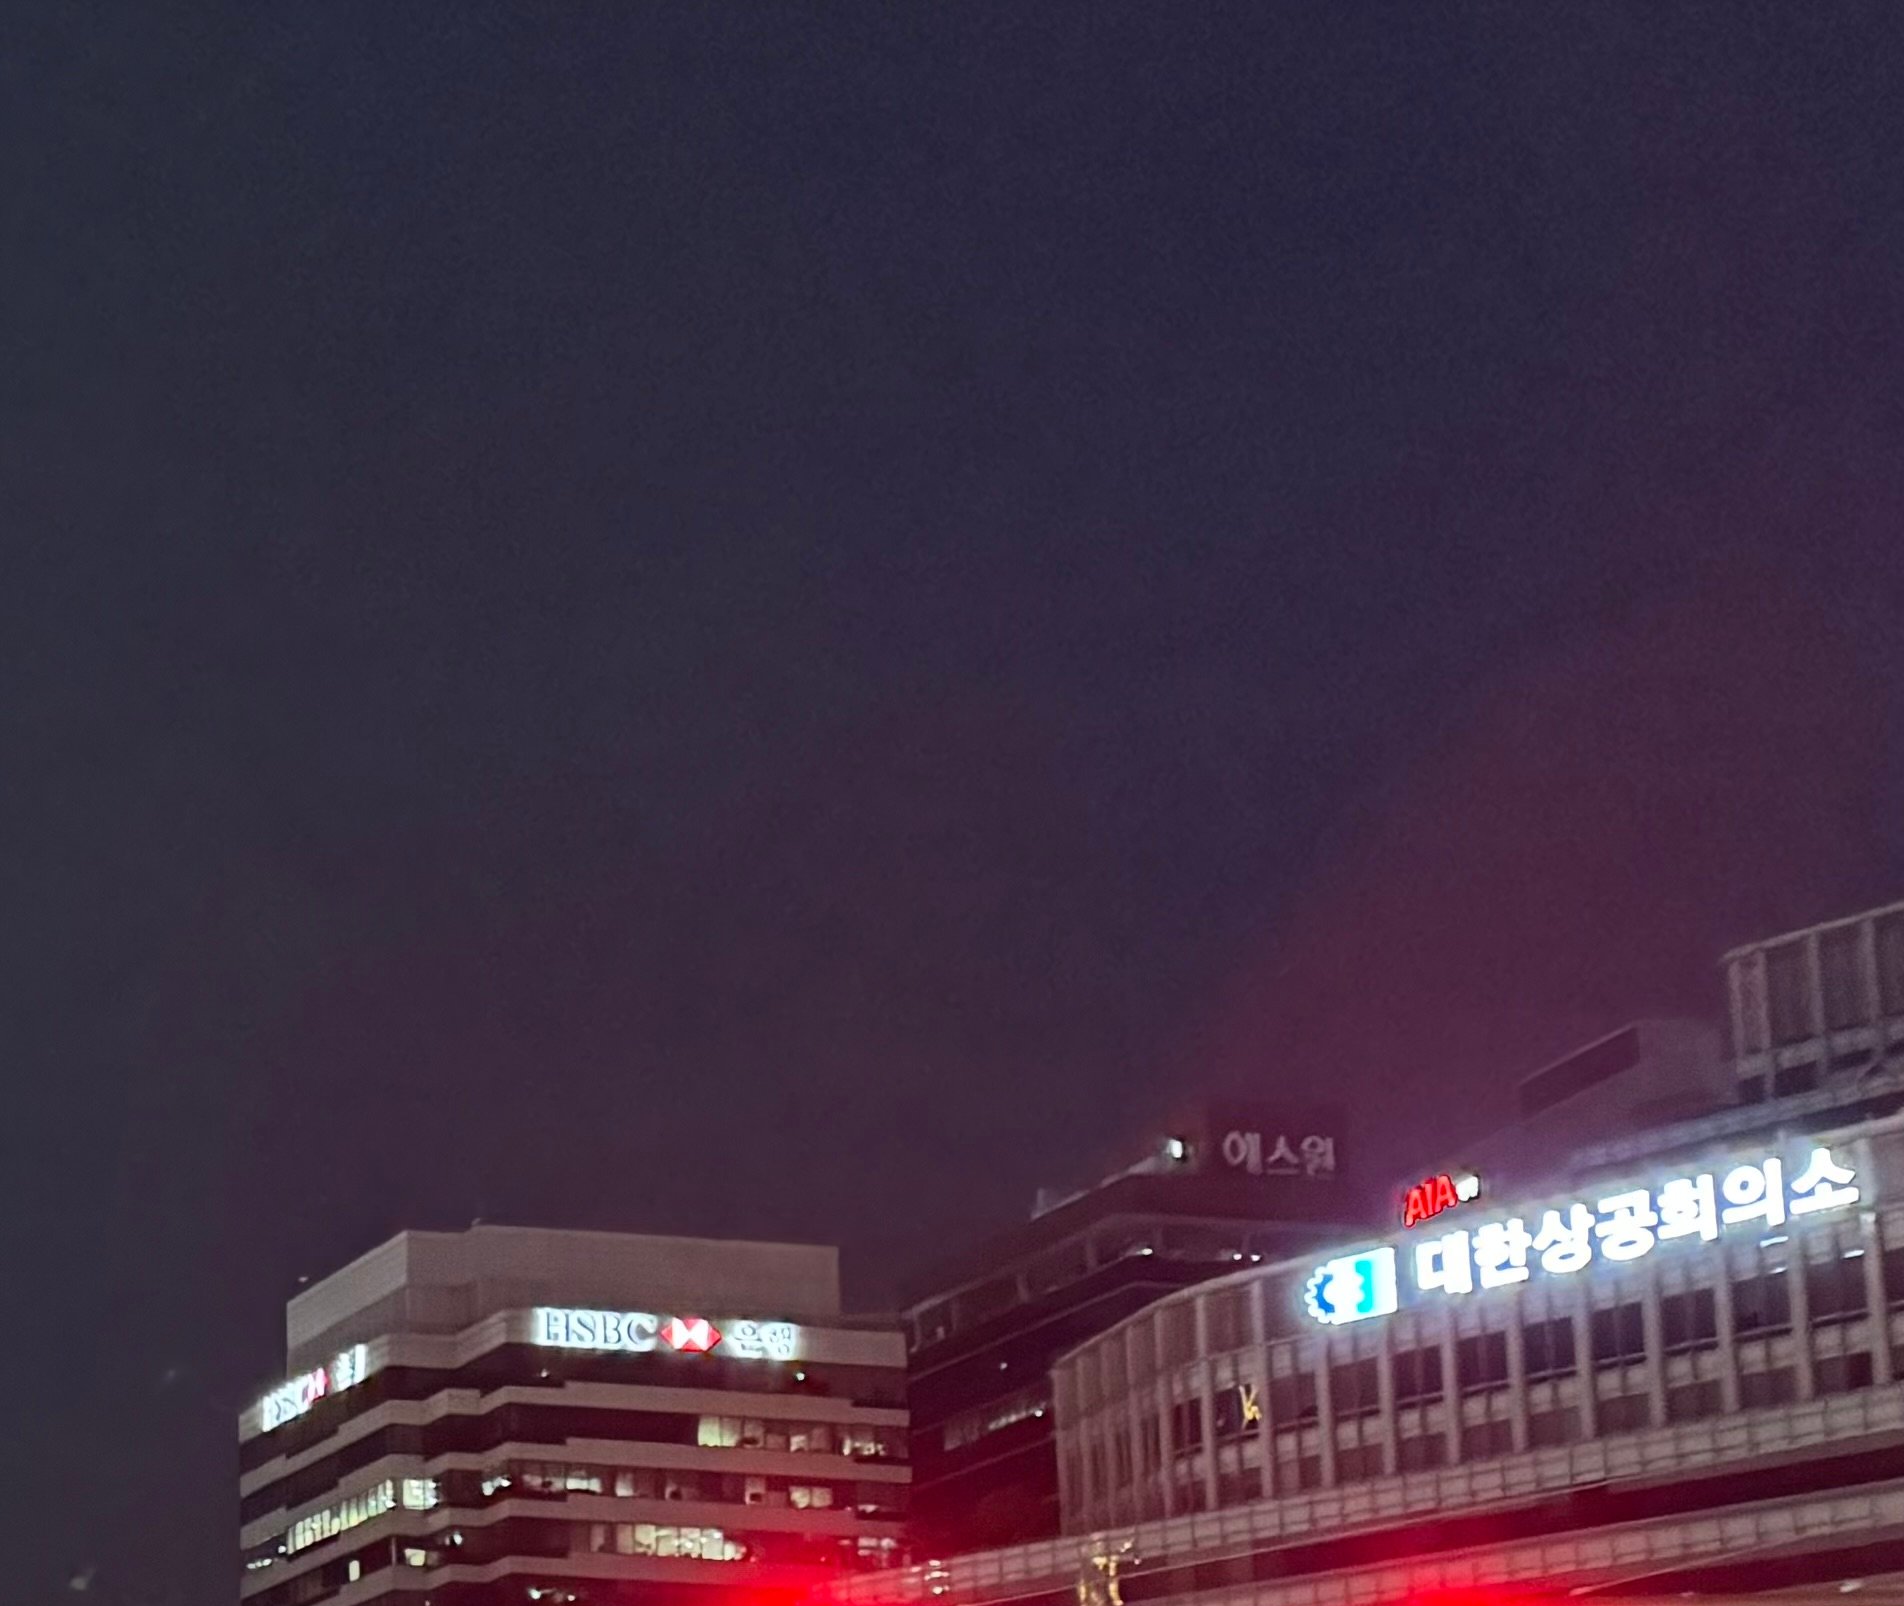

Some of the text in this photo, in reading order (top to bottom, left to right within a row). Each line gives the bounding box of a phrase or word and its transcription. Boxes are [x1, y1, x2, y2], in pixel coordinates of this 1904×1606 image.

[1223, 1131, 1336, 1180] 에스원
[1403, 1173, 1459, 1230] AIA
[1415, 1146, 1861, 1296] 대한상공회의소
[535, 1307, 798, 1361] HSBC 은행
